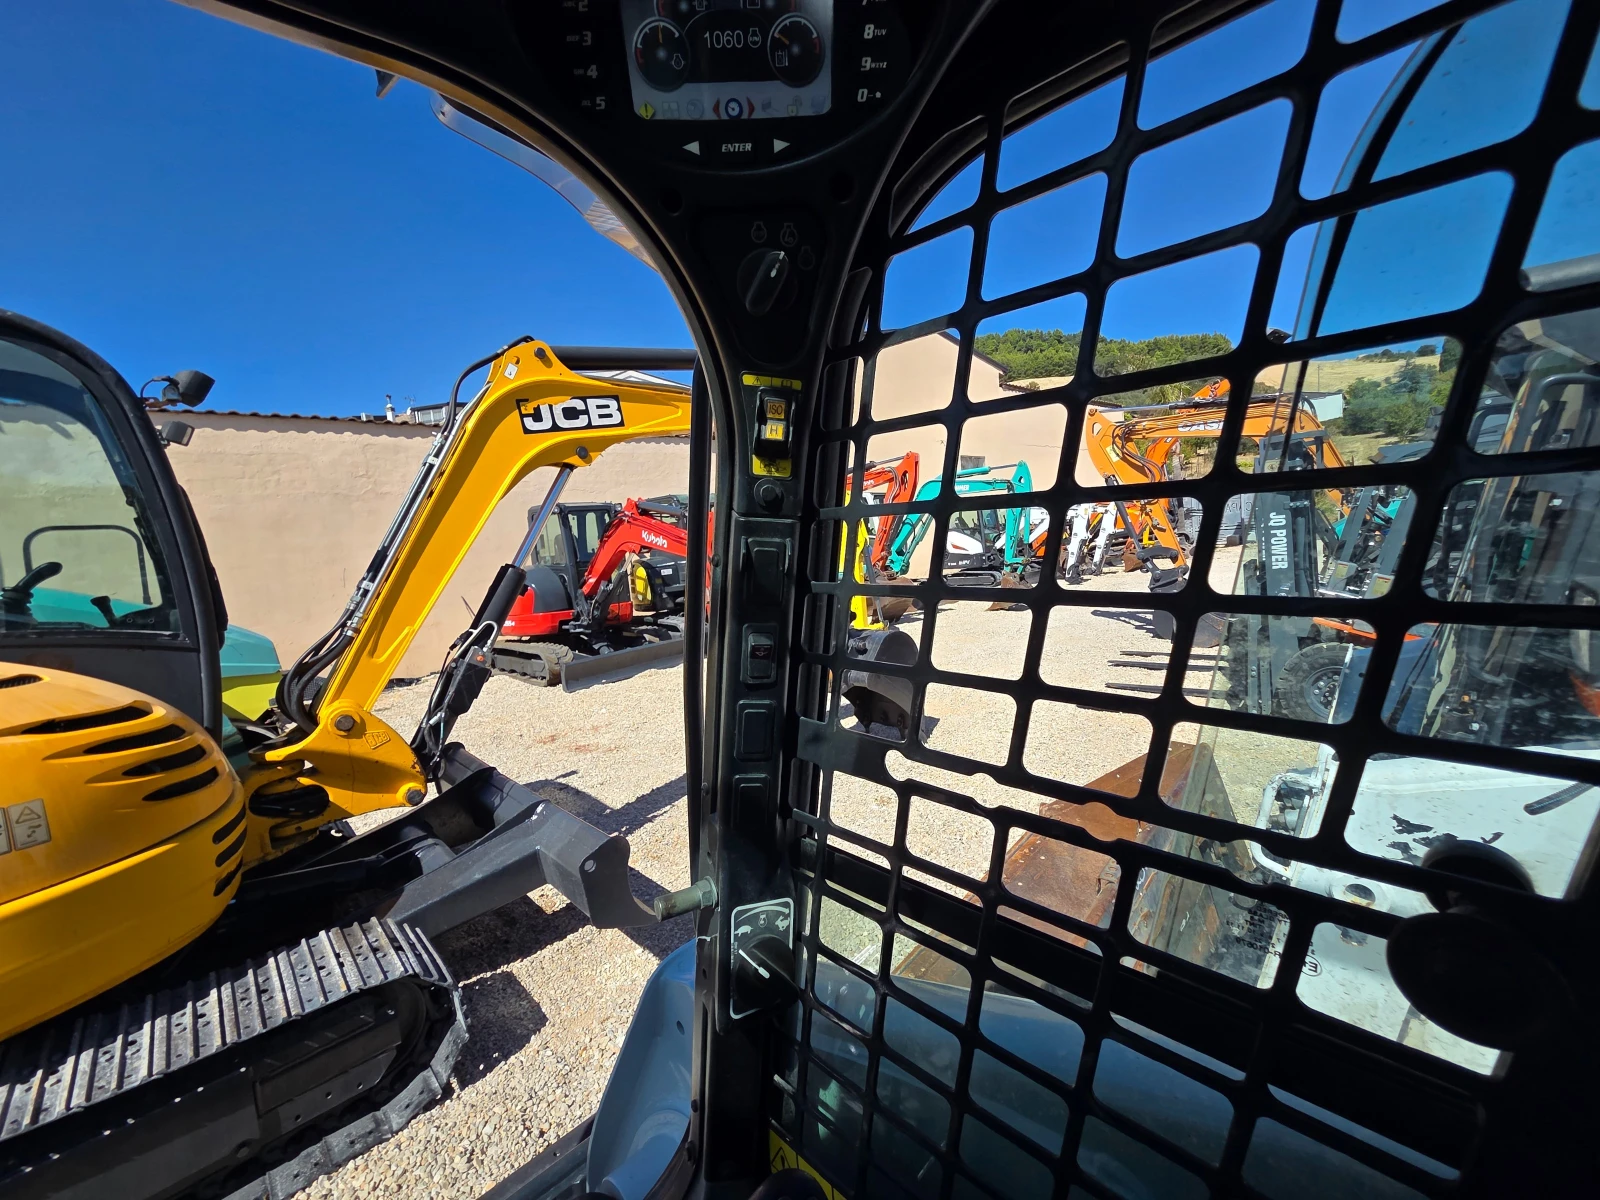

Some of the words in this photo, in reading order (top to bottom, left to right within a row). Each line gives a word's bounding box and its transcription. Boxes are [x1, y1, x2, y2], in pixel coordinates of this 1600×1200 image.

[582, 30, 592, 46] 3
[704, 30, 744, 48] 1060
[864, 24, 874, 40] 8
[874, 28, 888, 36] TUV
[860, 56, 872, 71] 9
[586, 64, 598, 79] 4
[857, 88, 868, 102] 0
[596, 96, 606, 110] 5
[721, 142, 752, 152] ENTER
[523, 398, 622, 431] JCB
[769, 404, 783, 415] ISO
[770, 424, 778, 435] H
[642, 530, 668, 548] Kubota
[1270, 529, 1288, 570] POWER
[366, 732, 388, 746] JCB
